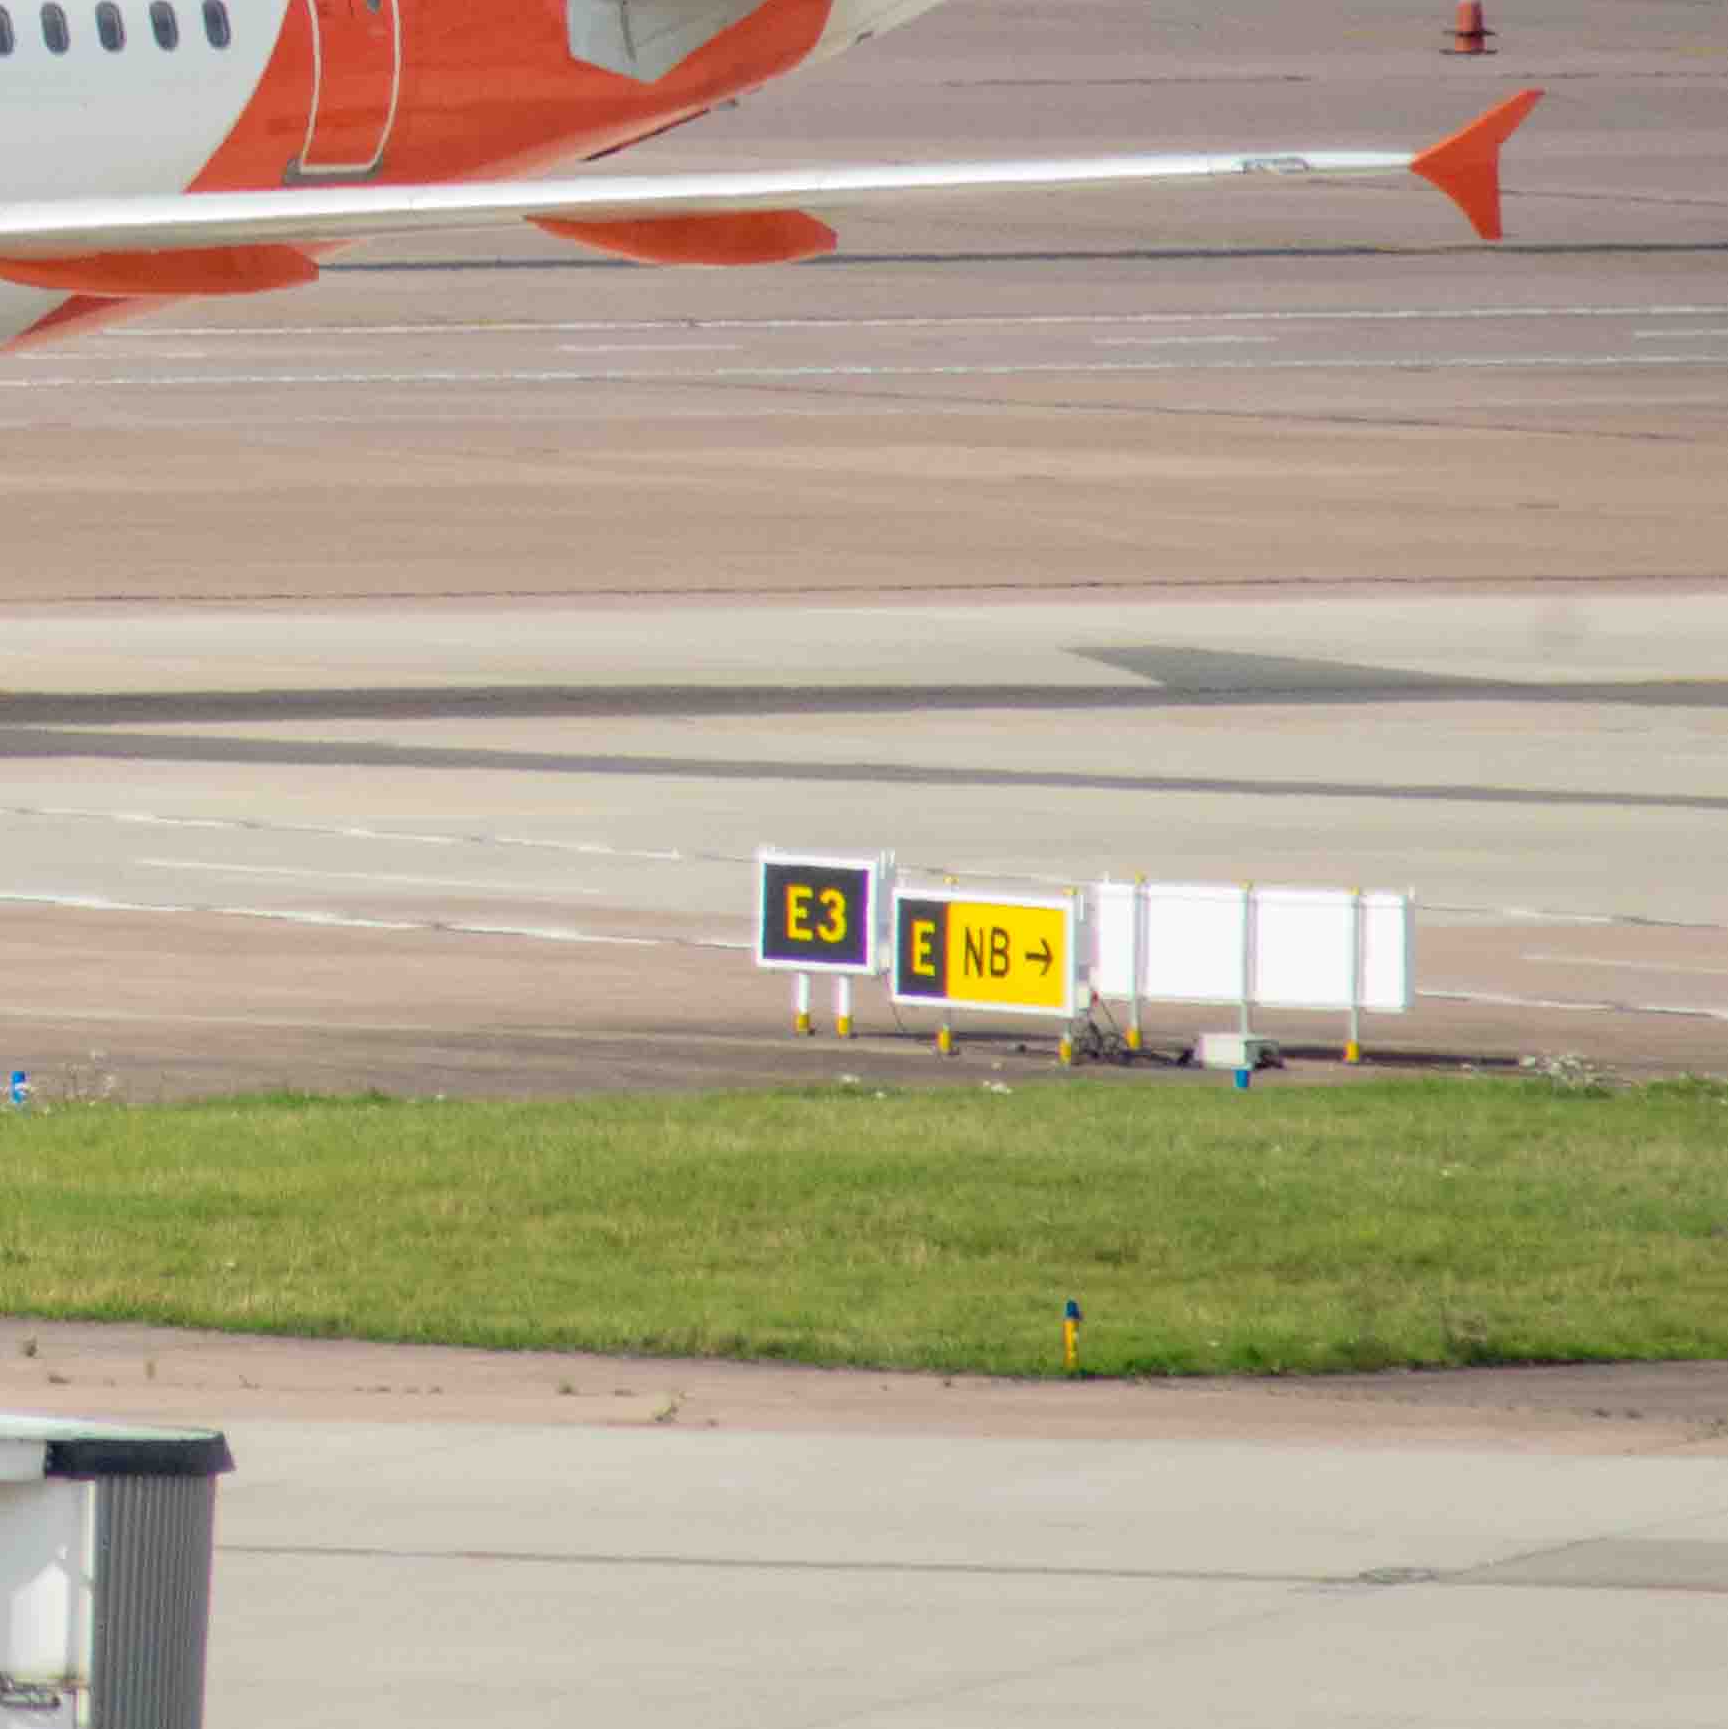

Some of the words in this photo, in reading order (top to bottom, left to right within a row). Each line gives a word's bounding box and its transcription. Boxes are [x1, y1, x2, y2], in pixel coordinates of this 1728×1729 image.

[784, 883, 848, 943] E3
[911, 919, 937, 976] E
[962, 926, 1011, 980] NB
